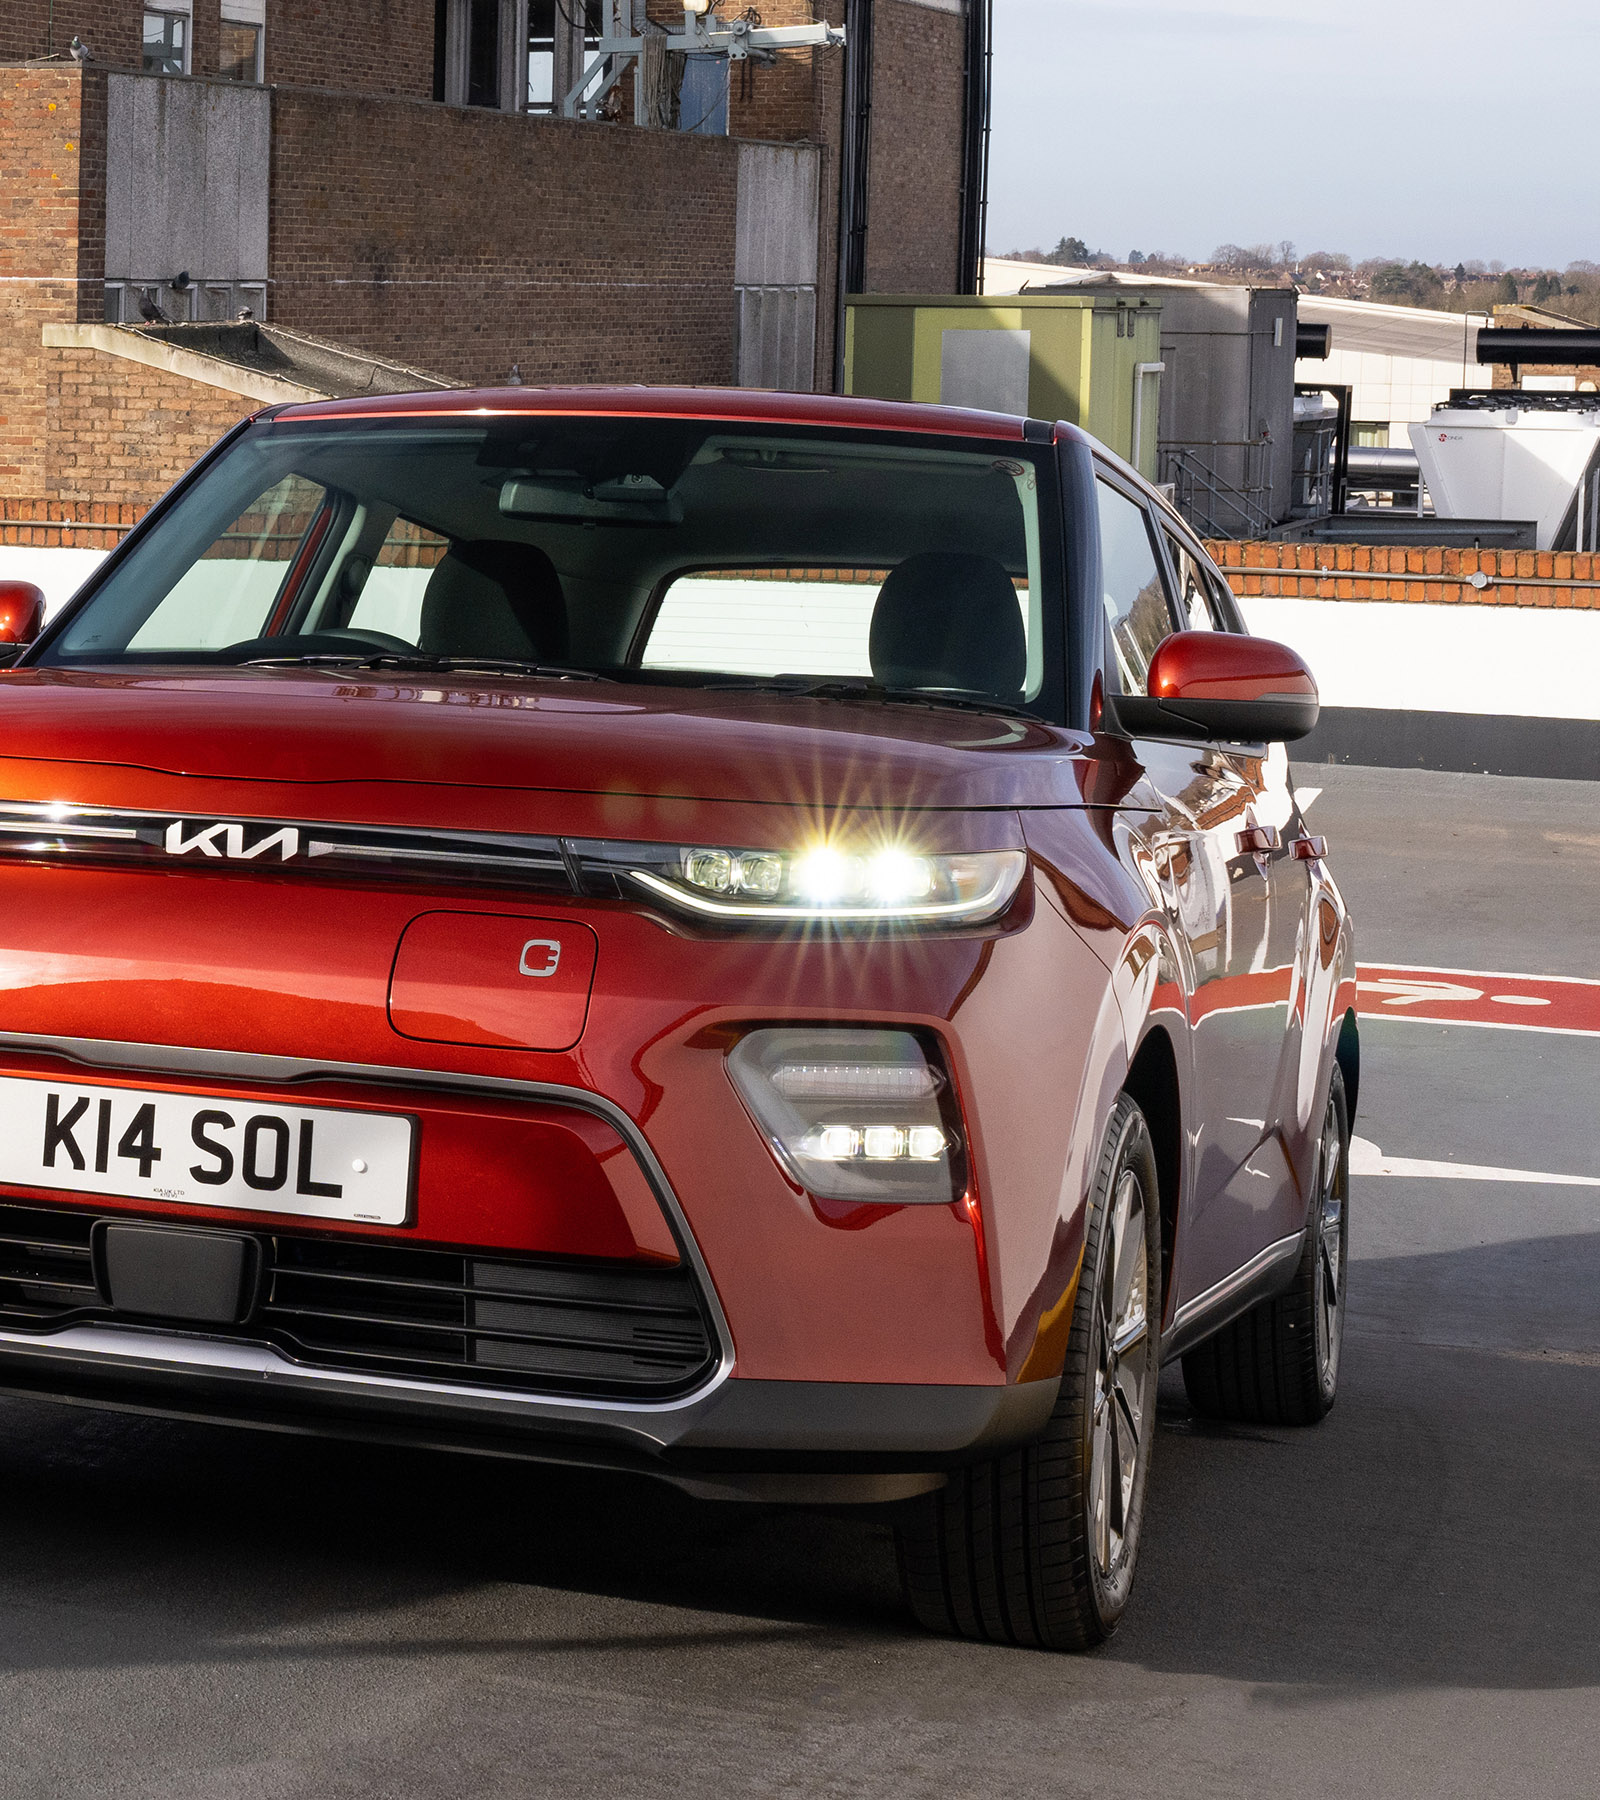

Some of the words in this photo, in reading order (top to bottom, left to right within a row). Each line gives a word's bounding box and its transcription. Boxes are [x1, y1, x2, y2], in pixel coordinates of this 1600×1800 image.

[165, 820, 299, 862] KIA
[42, 1093, 162, 1179] K14
[189, 1109, 343, 1199] SOL
